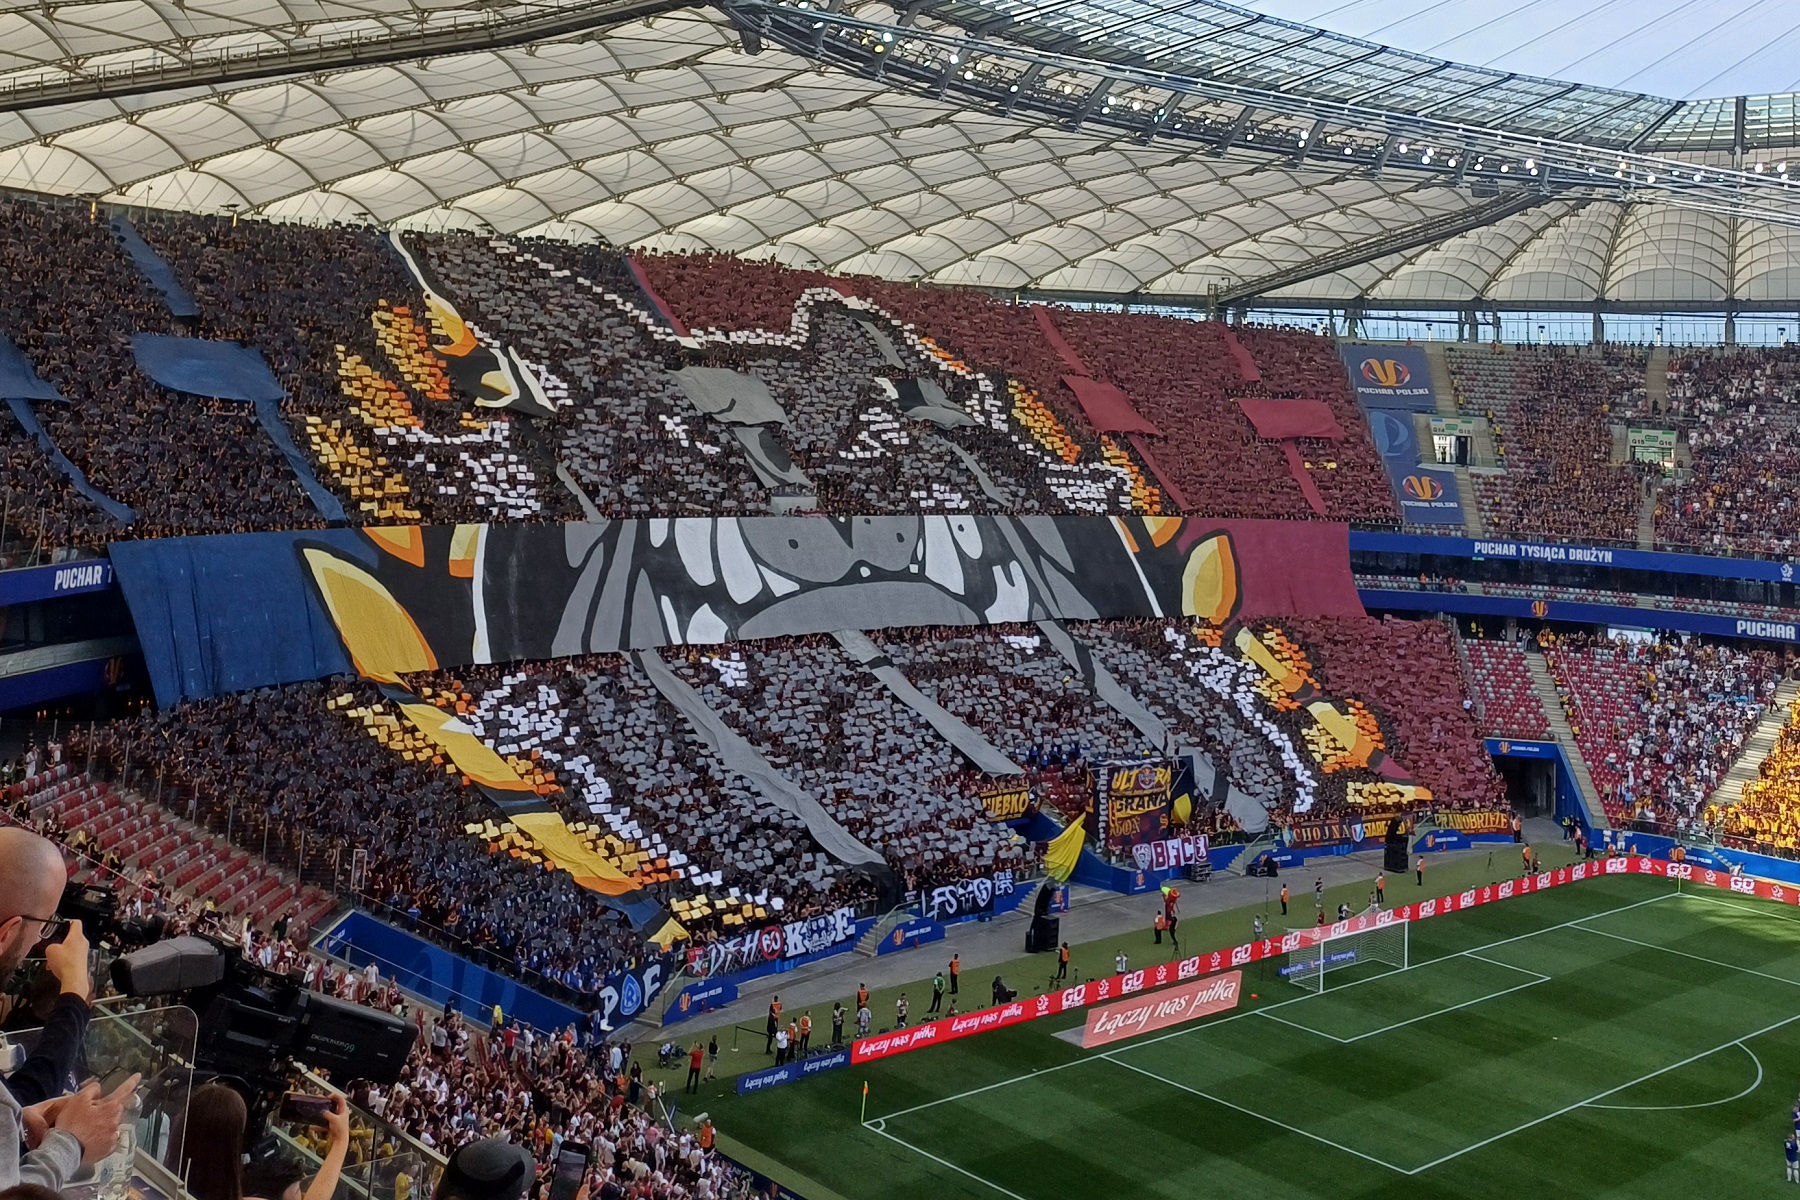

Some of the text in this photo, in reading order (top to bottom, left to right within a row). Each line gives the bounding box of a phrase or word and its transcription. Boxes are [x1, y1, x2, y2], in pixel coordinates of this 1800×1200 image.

[1357, 386, 1429, 396] PUCHAR POLSKI
[1474, 541, 1613, 563] PUCHAR TYSIĄCA DRUŻYN
[54, 565, 103, 591] PUCHAR
[1736, 620, 1796, 640] PUCHAR
[1293, 824, 1351, 842] CHOJNA
[1606, 857, 1628, 869] GO
[1499, 880, 1513, 896] GO
[1537, 872, 1551, 886] GO
[1730, 877, 1755, 890] GO
[1460, 889, 1476, 906] GO
[1419, 899, 1436, 916] GO
[1282, 931, 1300, 946] GO
[1231, 944, 1252, 963] GO
[1178, 956, 1200, 975] GO
[1122, 970, 1144, 989] GO
[1062, 984, 1086, 1004] GO
[1093, 978, 1236, 1034] Łączy nas piłka
[951, 1018, 980, 1033] Łączy
[981, 1012, 998, 1025] nas
[998, 1003, 1023, 1023] piłka
[858, 1024, 936, 1056] Łączy nas piłka
